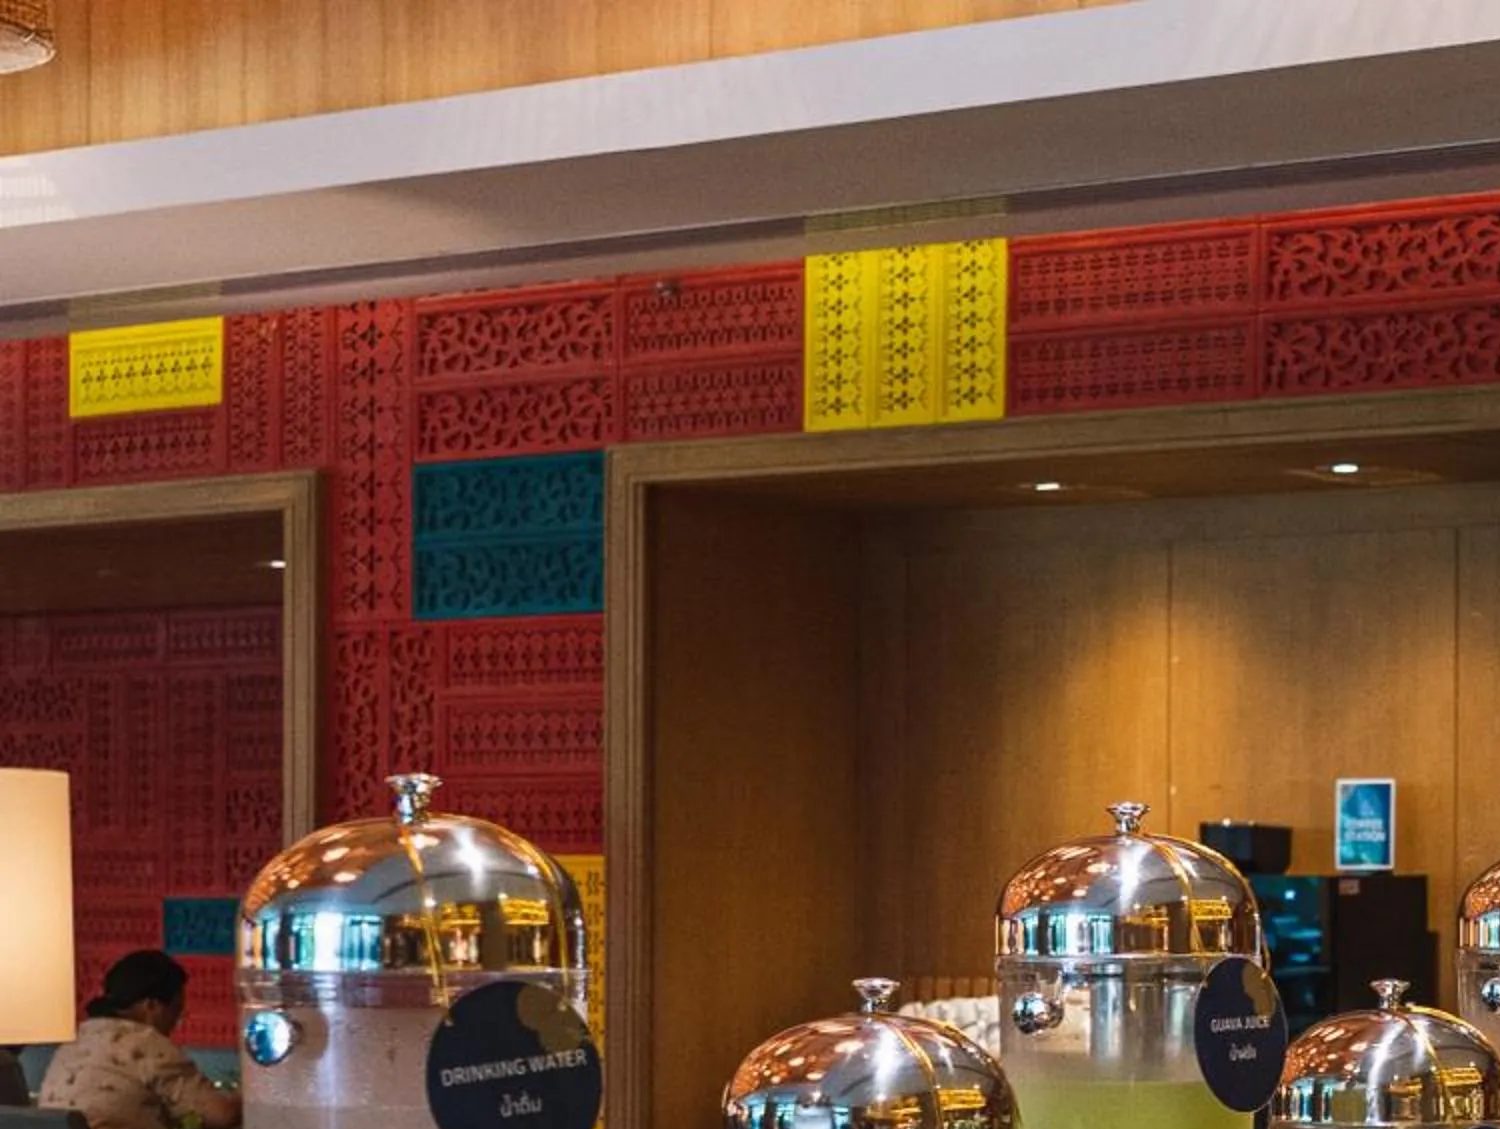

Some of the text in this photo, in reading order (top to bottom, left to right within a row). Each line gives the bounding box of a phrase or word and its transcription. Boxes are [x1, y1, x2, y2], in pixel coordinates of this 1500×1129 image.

[1210, 1015, 1270, 1033] GUAVA JUICE
[440, 1048, 588, 1087] DRINKING WATER
[500, 1090, 542, 1118] น้ำดื่ม
